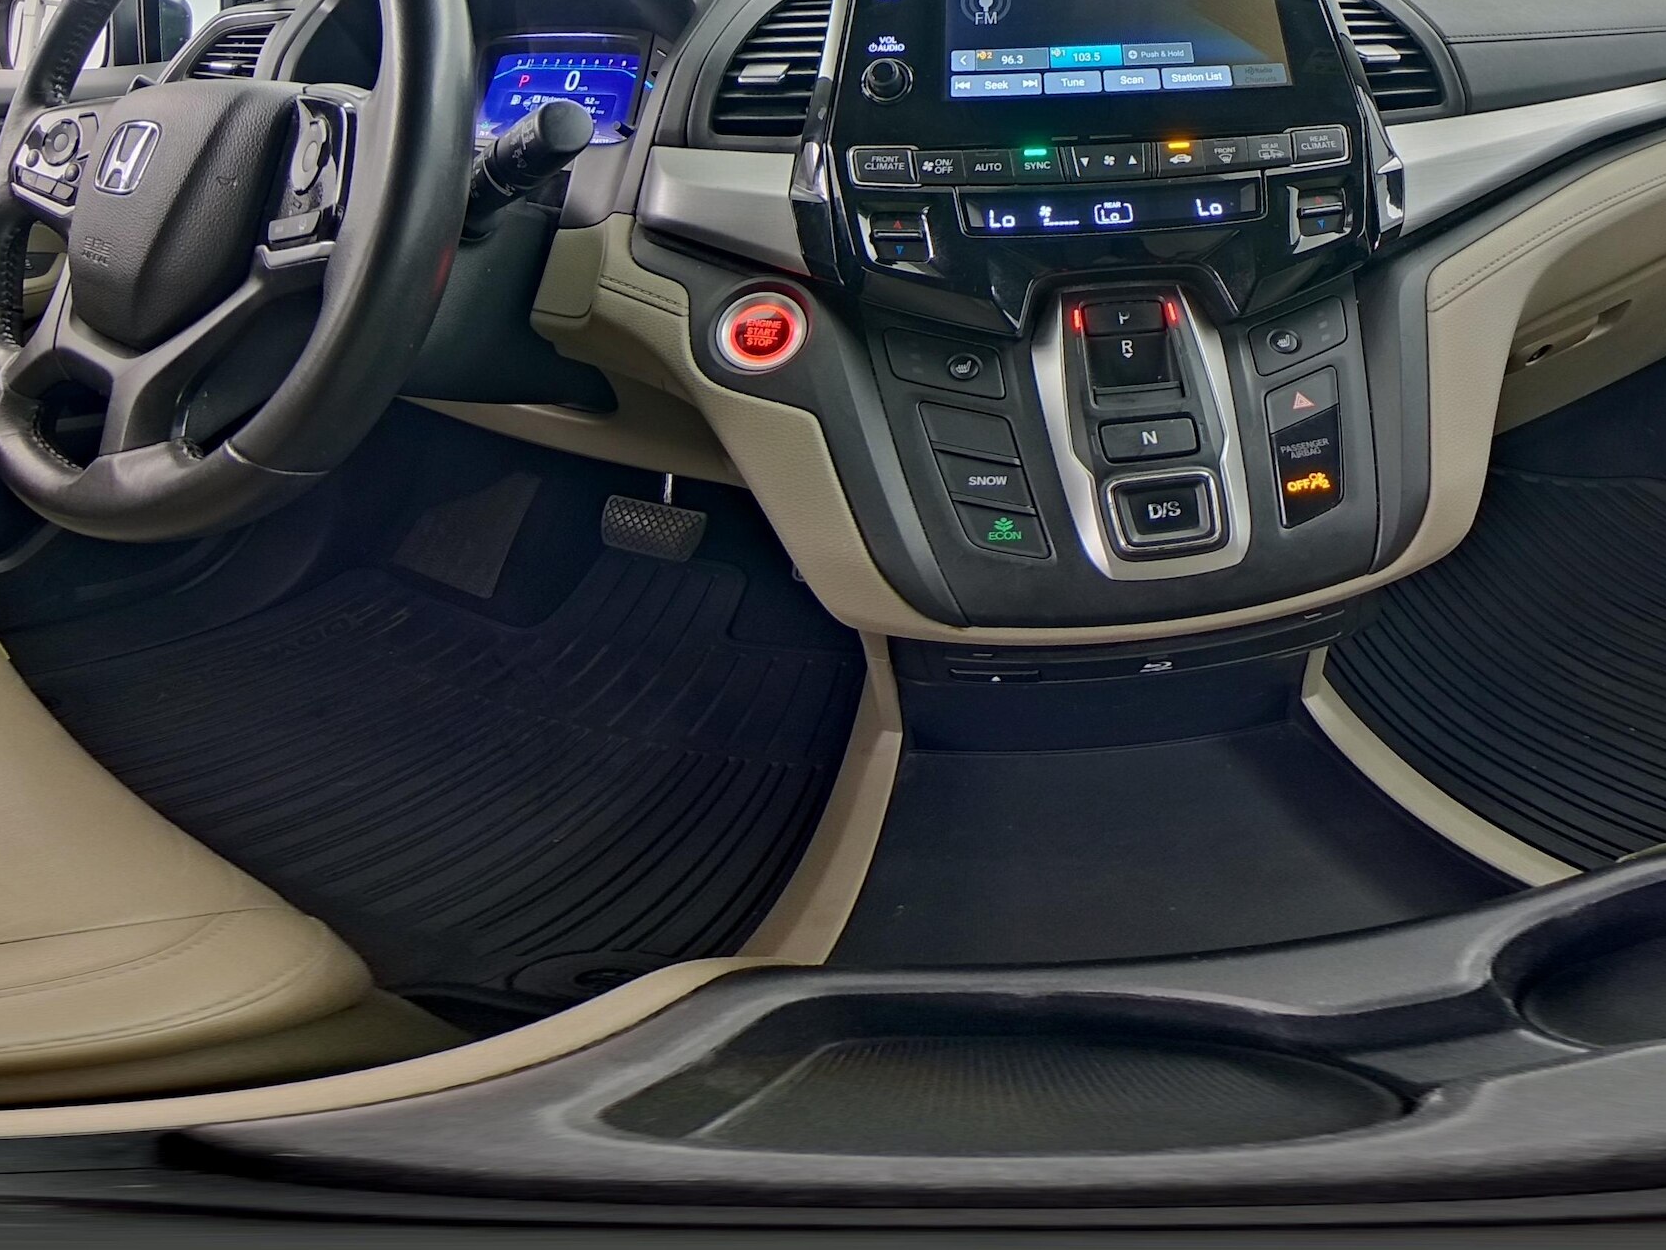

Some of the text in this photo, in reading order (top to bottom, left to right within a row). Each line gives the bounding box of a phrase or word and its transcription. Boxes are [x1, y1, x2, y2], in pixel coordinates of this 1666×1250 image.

[974, 11, 998, 25] FM
[879, 36, 897, 44] VOL
[877, 44, 905, 52] AUDIO
[1001, 55, 1024, 65] 96.3
[1073, 52, 1100, 62] 103.5
[519, 75, 530, 88] P
[564, 70, 581, 91] 0
[1061, 78, 1085, 87] Tune
[1120, 76, 1144, 85] Scan
[1171, 72, 1223, 83] Station List
[985, 81, 1009, 90] Seek
[1309, 135, 1328, 143] REAR
[1301, 140, 1337, 150] CLIMATE
[864, 162, 905, 171] CLIMATE
[935, 158, 953, 167] ON/
[974, 163, 1002, 171] AUTO
[1024, 161, 1051, 170] SYNC
[935, 166, 953, 174] OFF
[1196, 199, 1222, 217] Lo
[989, 209, 1016, 228] Lo
[746, 318, 782, 328] ENGINE
[746, 327, 778, 336] START
[746, 338, 773, 347] STOP
[1121, 340, 1133, 353] R
[1142, 430, 1158, 445] N
[1279, 438, 1330, 454] PASSENGER
[1290, 447, 1322, 459] AIRBAG
[968, 476, 1007, 486] SNOW
[1286, 478, 1311, 492] OFF
[1148, 501, 1182, 520] D/S
[988, 531, 1022, 540] ECON
